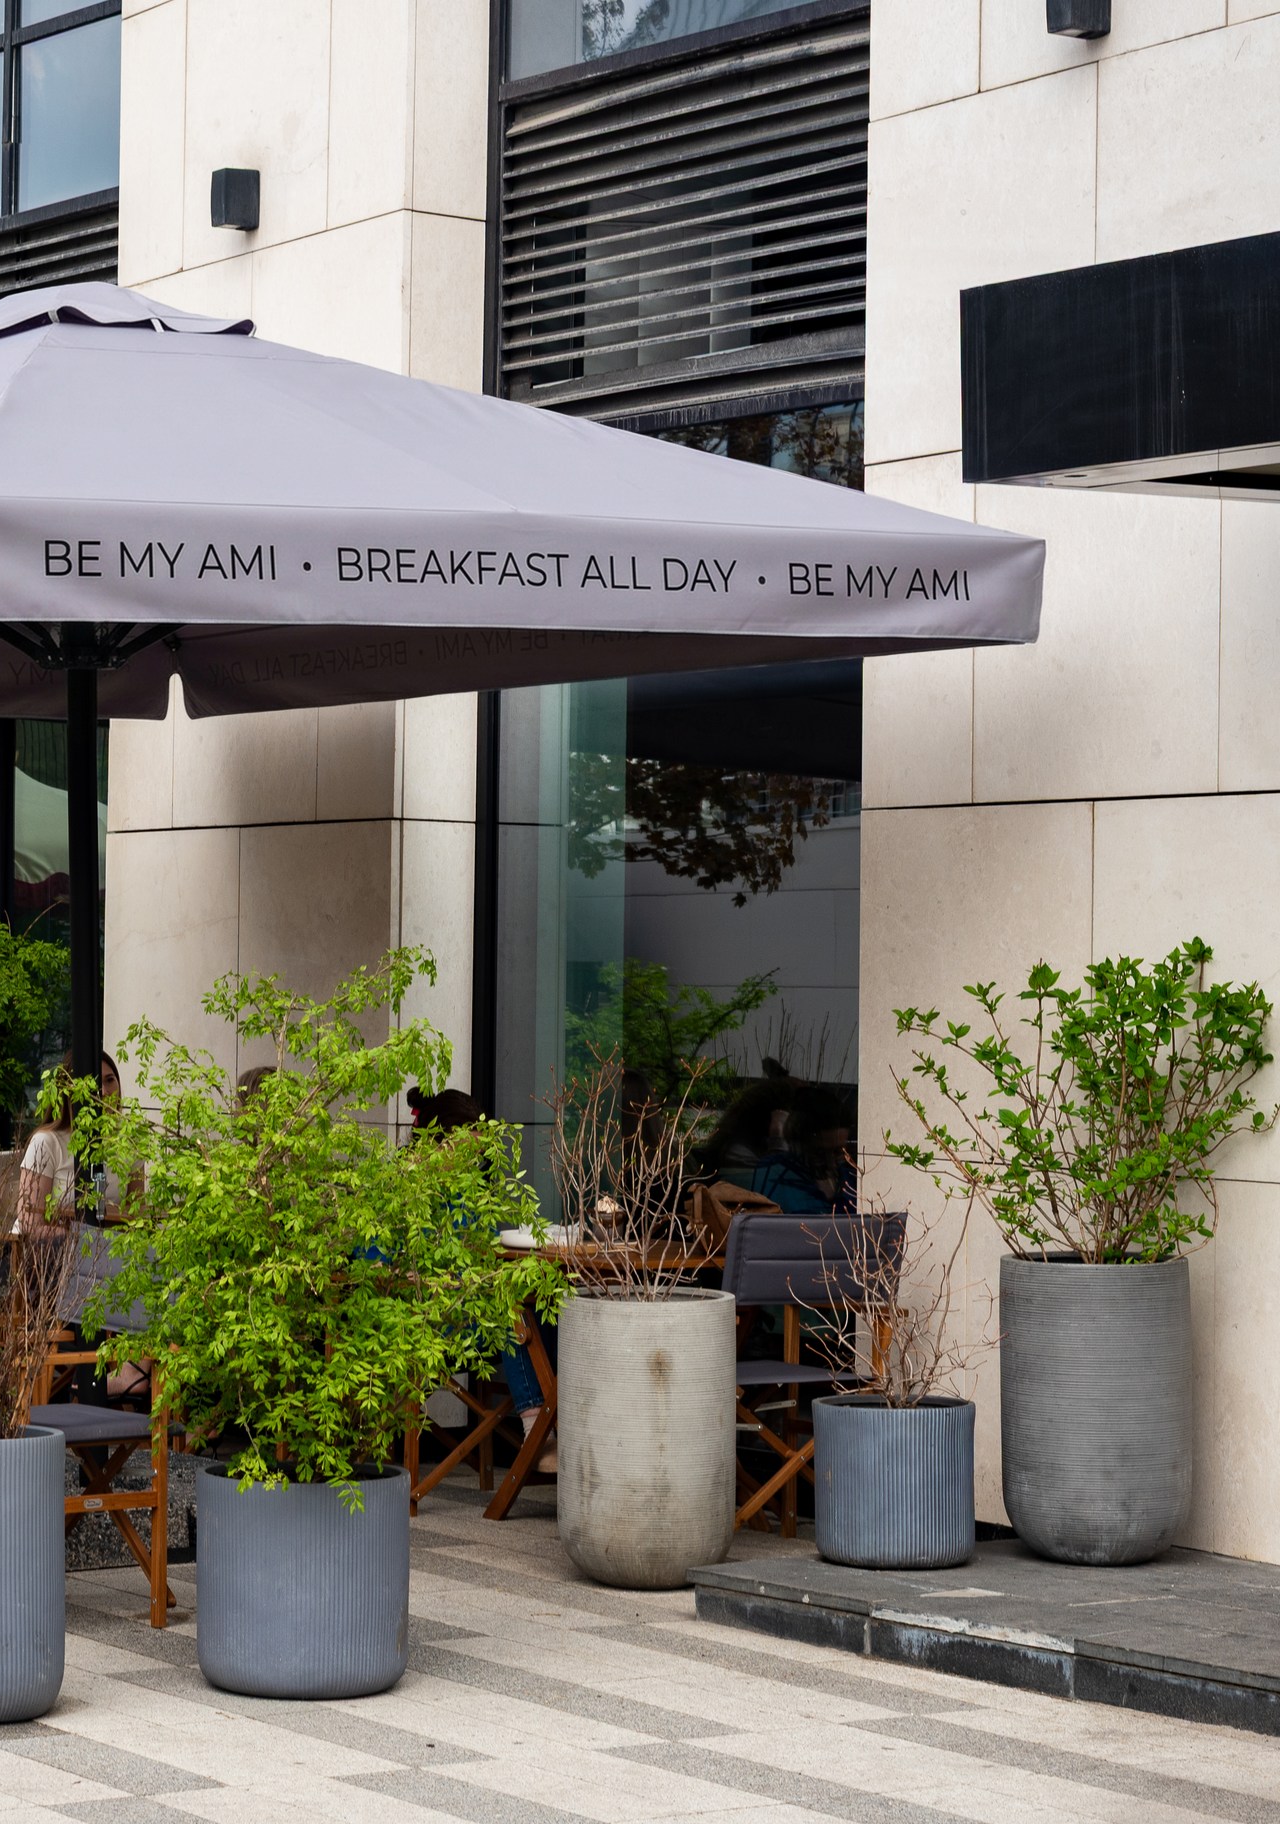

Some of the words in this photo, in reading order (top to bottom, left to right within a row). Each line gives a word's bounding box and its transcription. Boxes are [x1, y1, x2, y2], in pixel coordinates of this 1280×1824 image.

[45, 540, 102, 577] BE
[120, 540, 184, 578] MY
[198, 543, 276, 581] AMI
[338, 546, 569, 588] BREAKFAST
[581, 554, 651, 590] ALL
[663, 558, 737, 593] DAY
[789, 562, 834, 596] BE
[847, 564, 897, 599] MY
[906, 567, 970, 602] AMI
